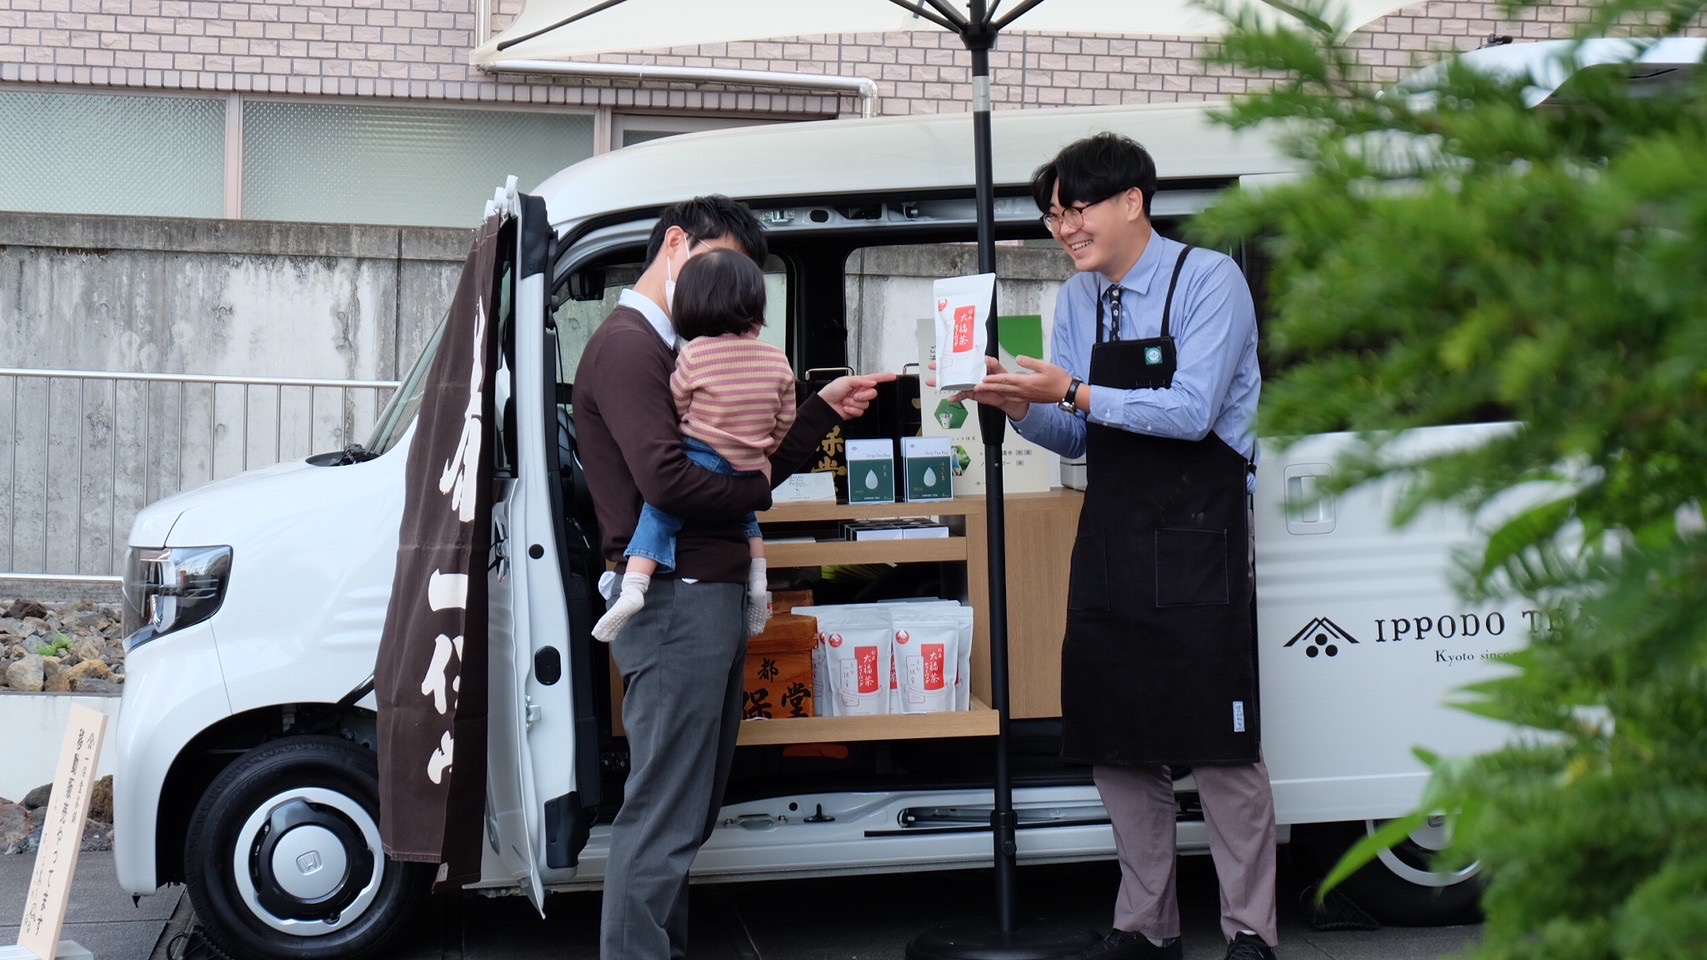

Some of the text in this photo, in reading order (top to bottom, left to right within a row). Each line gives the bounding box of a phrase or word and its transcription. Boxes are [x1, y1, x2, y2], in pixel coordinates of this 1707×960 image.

[959, 314, 969, 346] 大福茶
[1374, 611, 1506, 643] IPPODO
[863, 653, 875, 687] 大福茶
[930, 651, 941, 685] 大福茶
[1435, 649, 1475, 666] Kyoto
